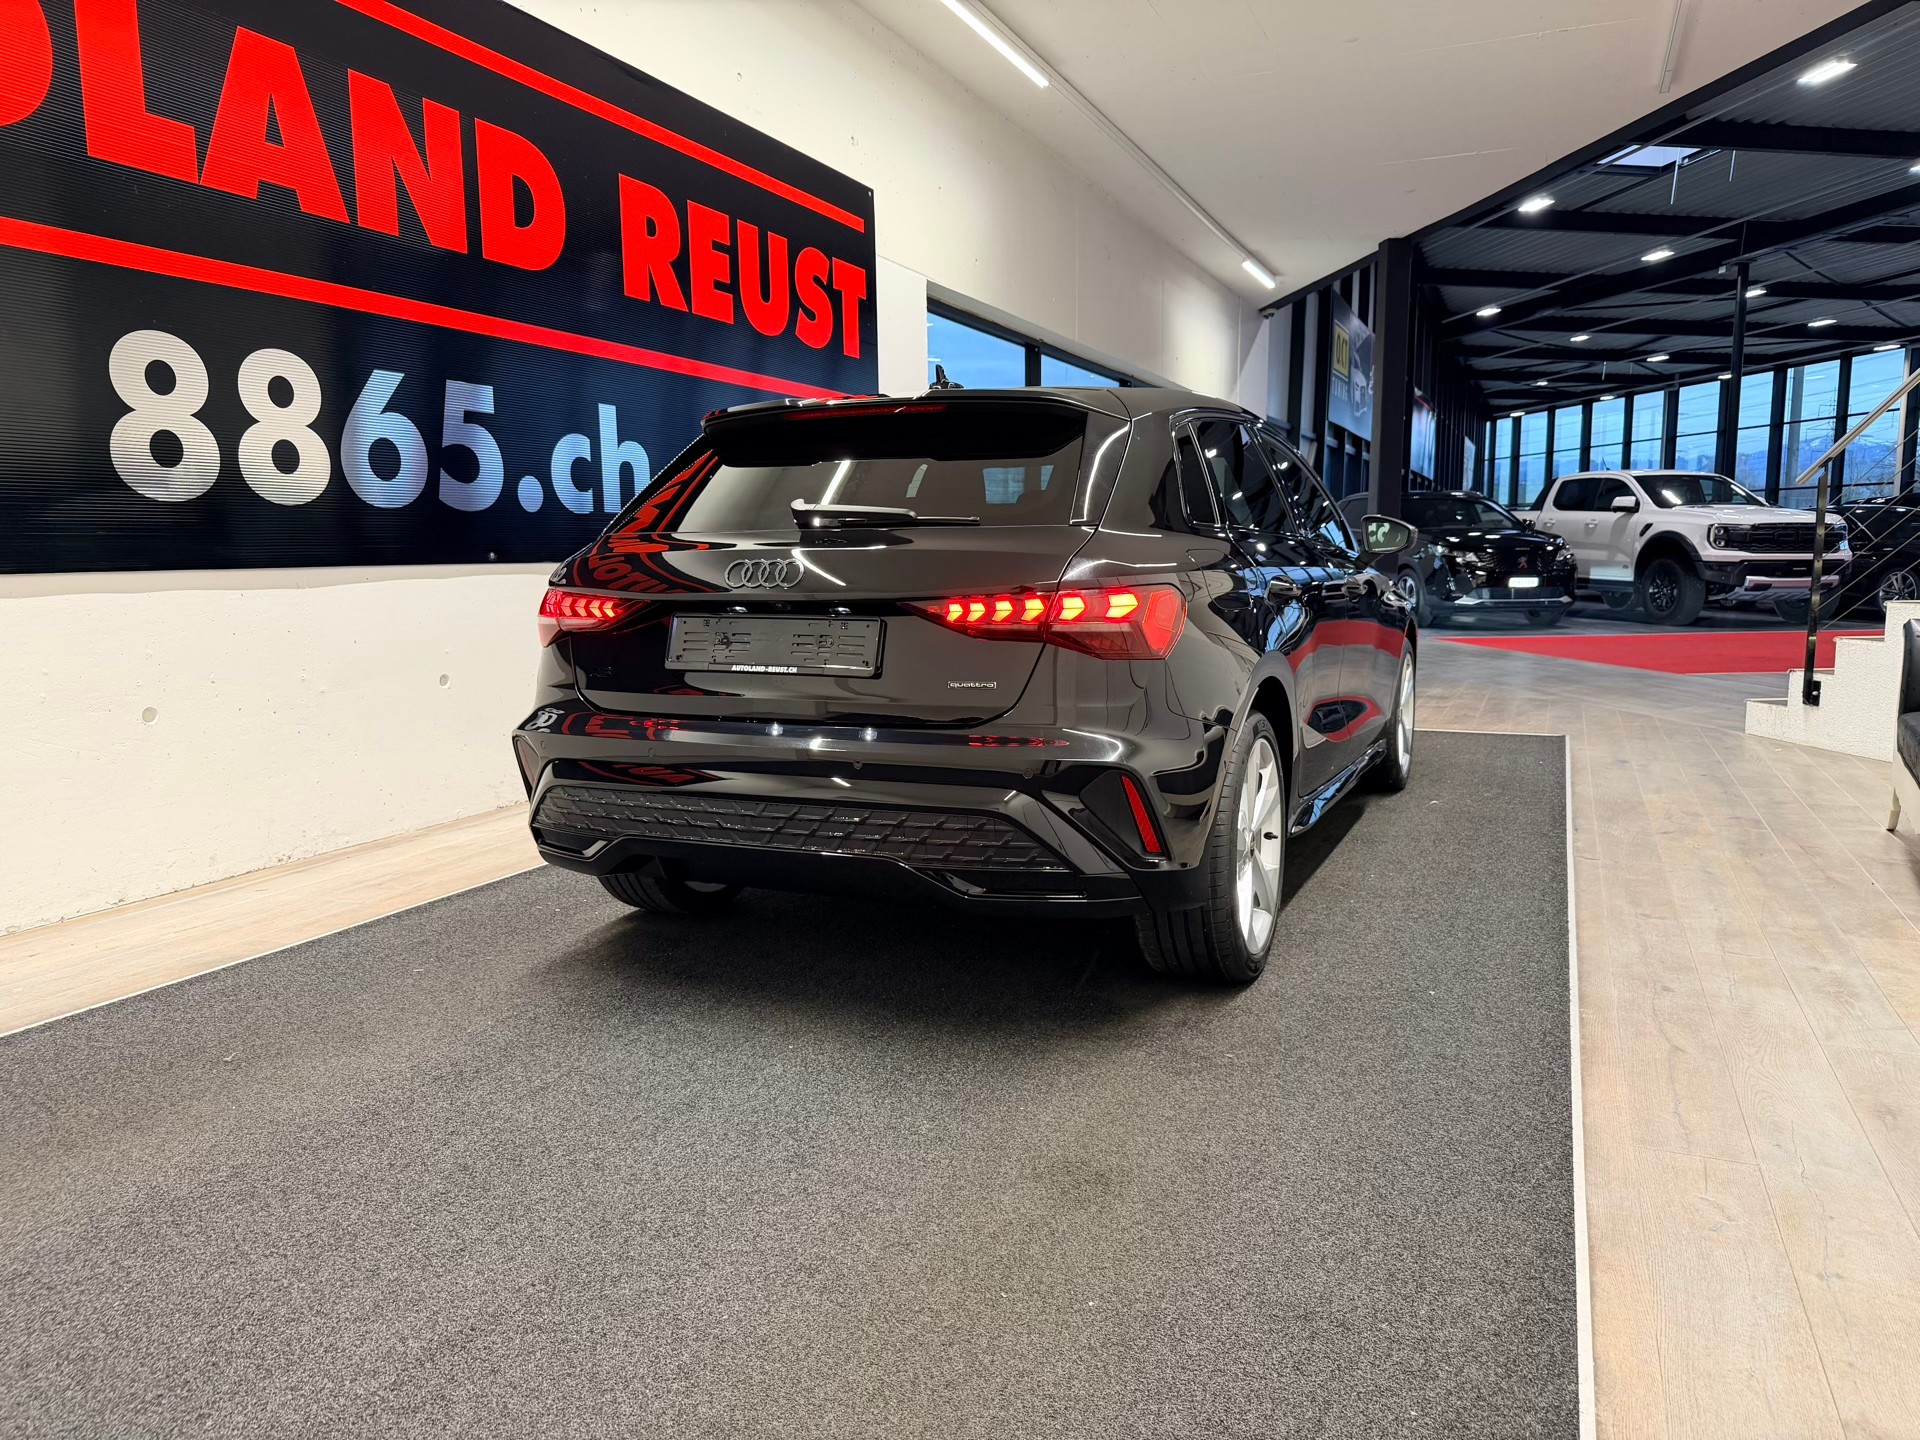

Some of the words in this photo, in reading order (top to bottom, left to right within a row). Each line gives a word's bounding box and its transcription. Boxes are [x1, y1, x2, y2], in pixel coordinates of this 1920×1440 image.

[618, 173, 866, 359] REUST
[109, 329, 650, 514] 8865.ch
[731, 664, 798, 674] AUTOLAND-REUST.CH
[949, 681, 995, 689] quattro
